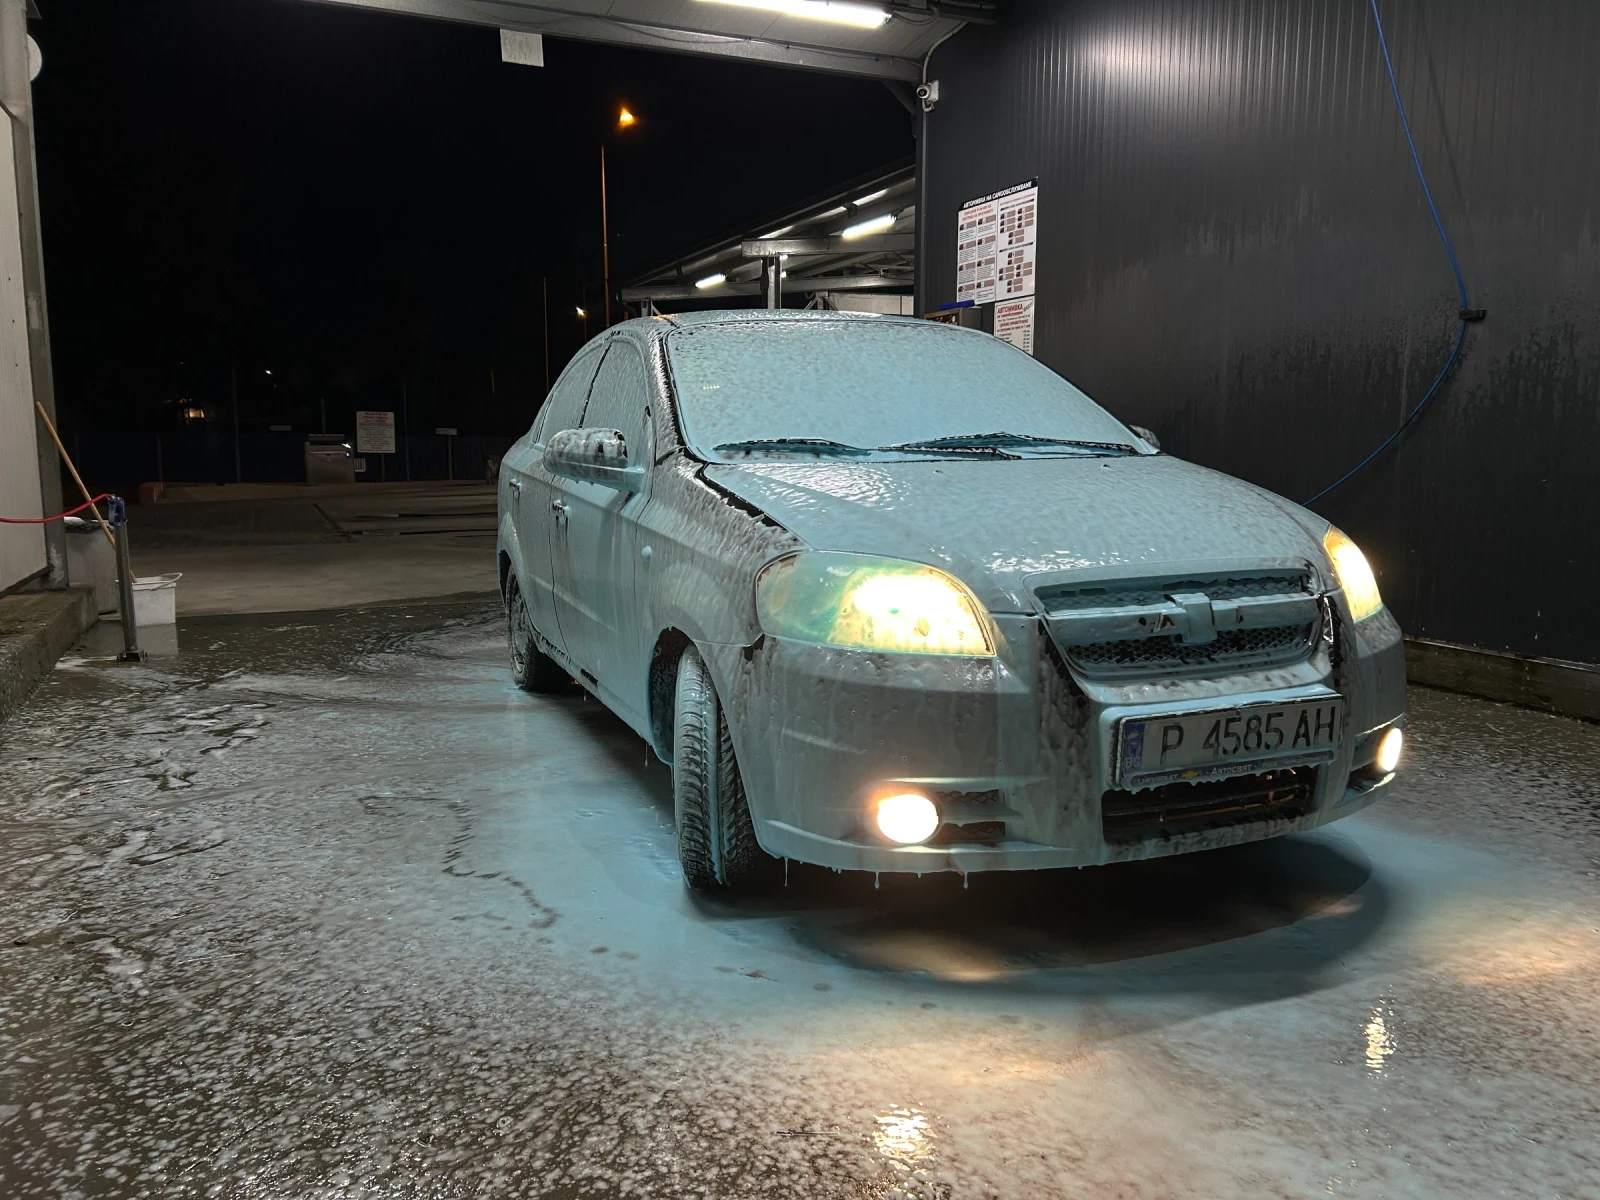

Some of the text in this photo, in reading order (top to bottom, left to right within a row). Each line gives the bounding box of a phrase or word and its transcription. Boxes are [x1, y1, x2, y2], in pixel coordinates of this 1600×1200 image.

[963, 196, 986, 209] АВТОМИВКА
[997, 304, 1023, 313] АВТОМИВКА
[1160, 706, 1336, 765] P 4585 AH
[1125, 757, 1140, 769] BG
